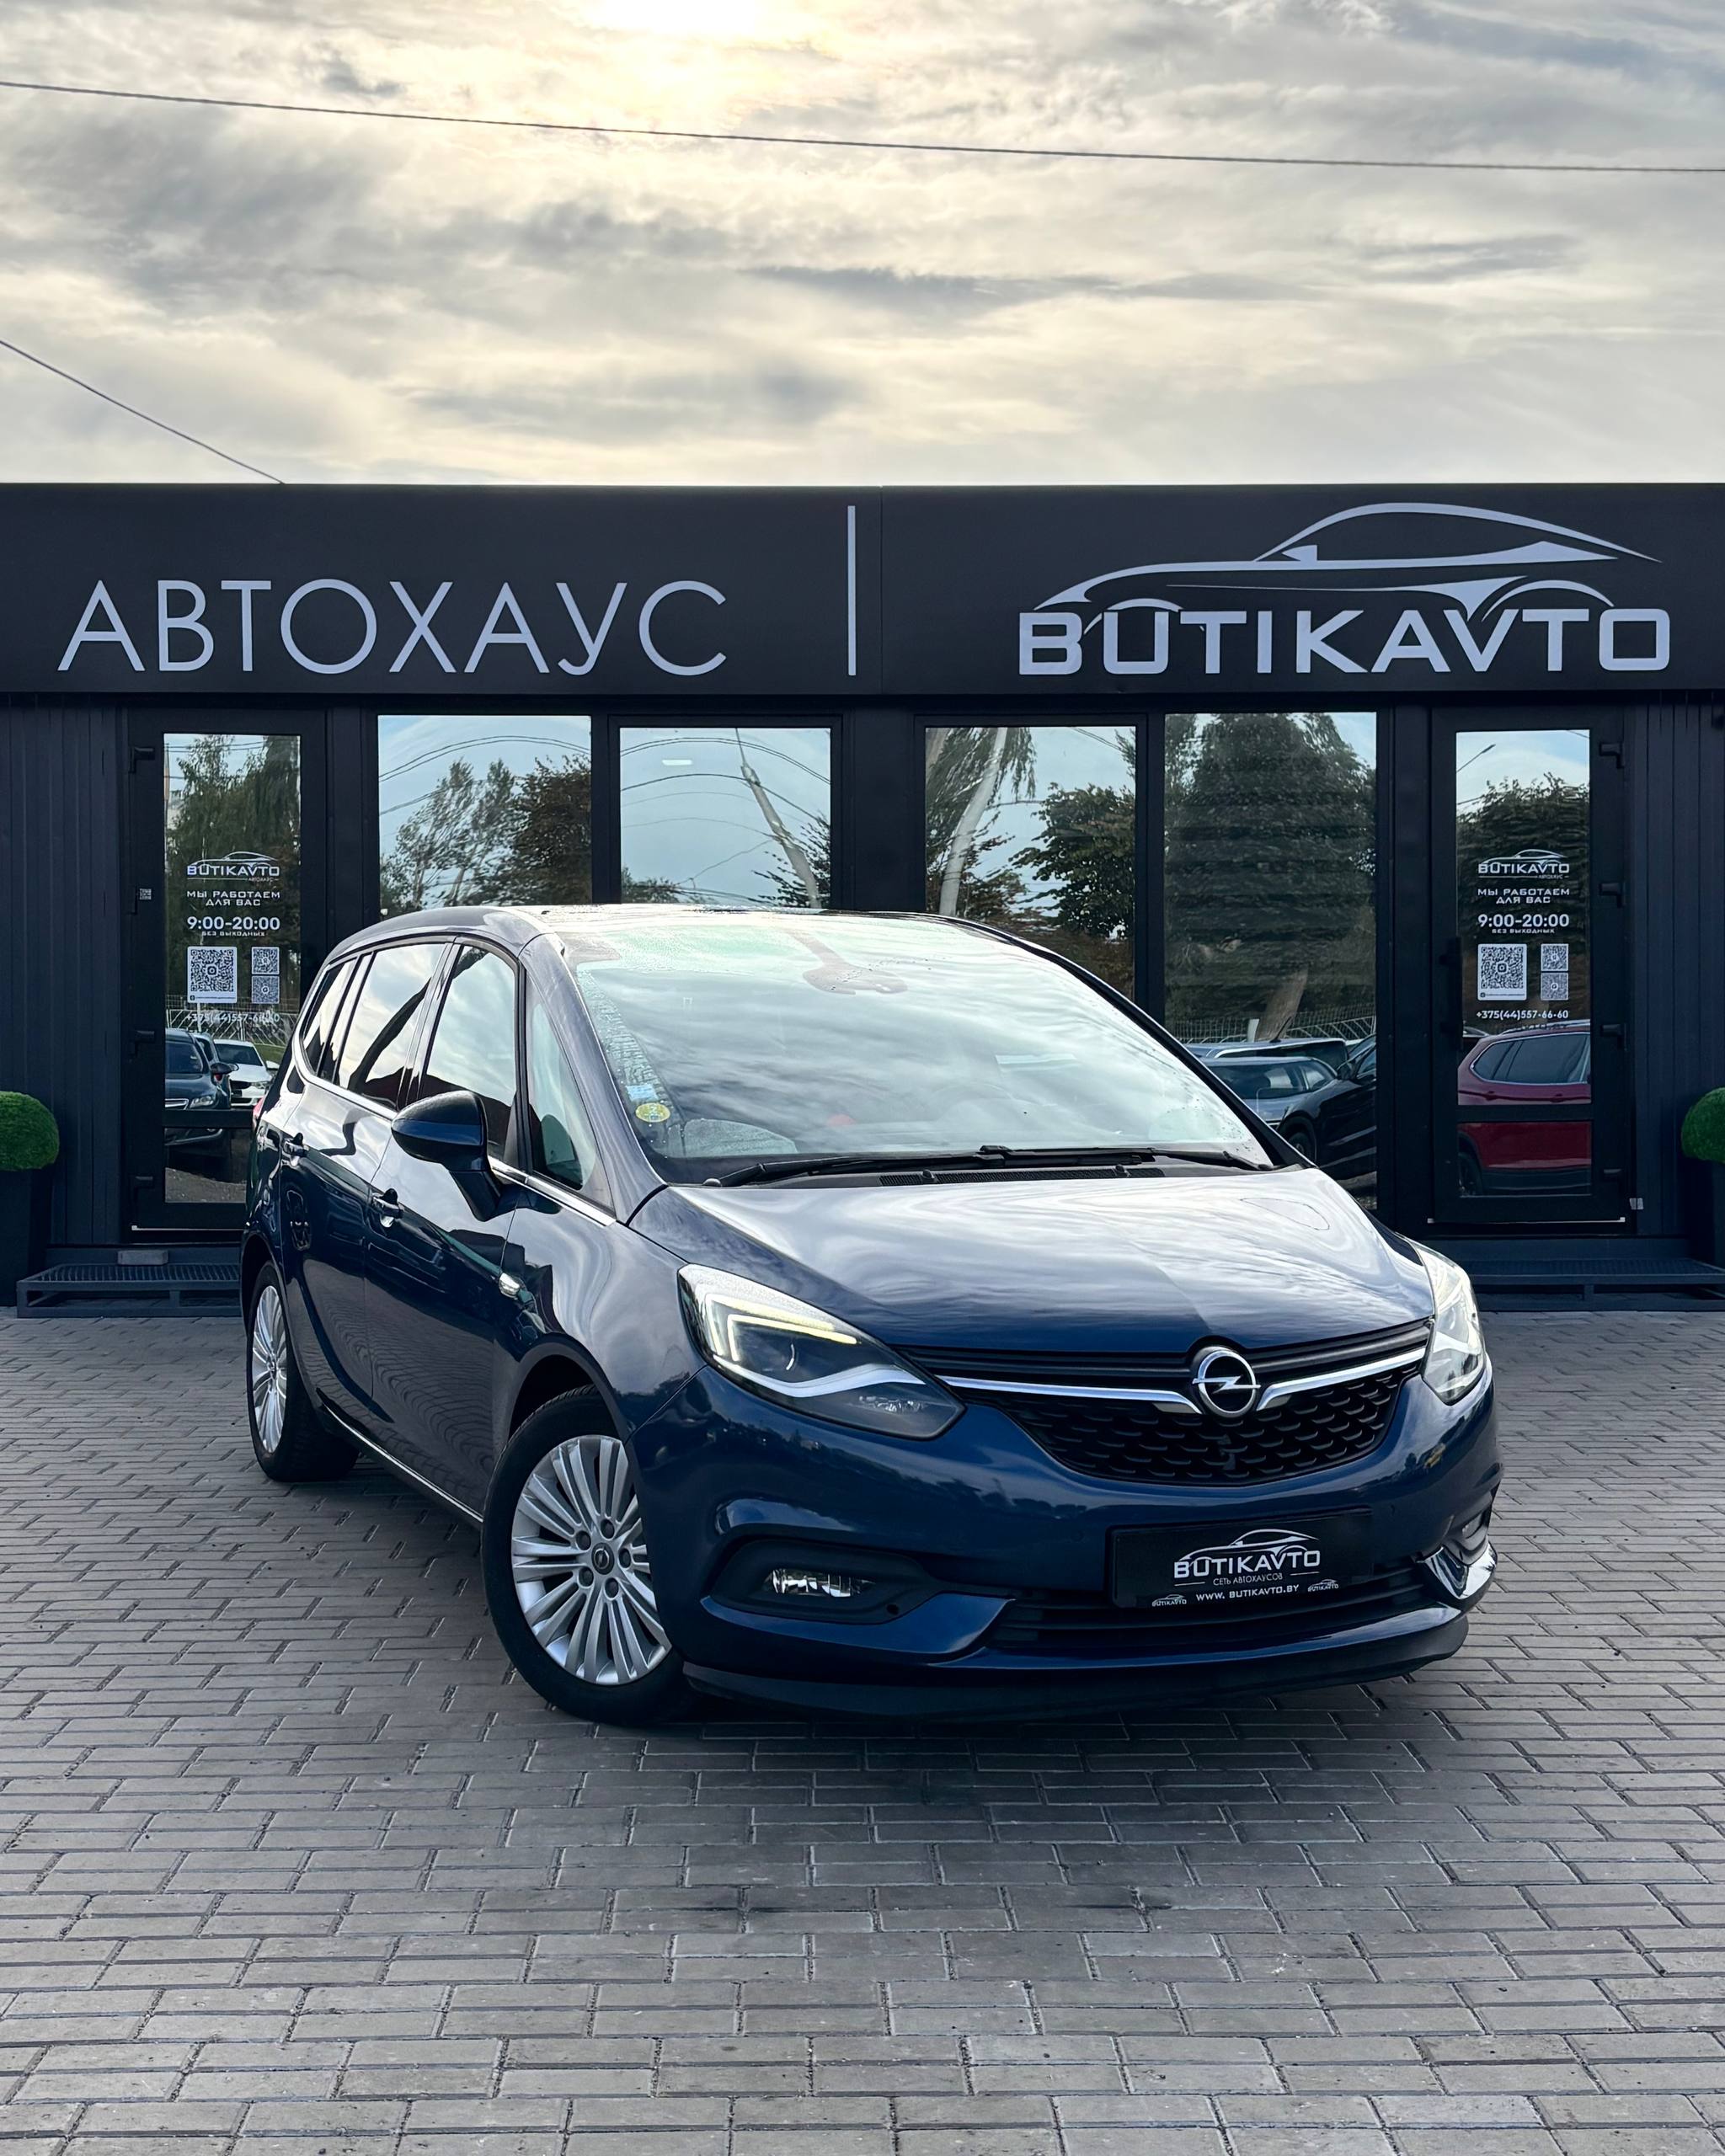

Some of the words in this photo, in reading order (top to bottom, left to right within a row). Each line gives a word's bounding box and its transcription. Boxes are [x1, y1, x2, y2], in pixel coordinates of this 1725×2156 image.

[58, 579, 727, 676] АВТОХАУС
[1019, 607, 1671, 675] BUTIKAVTO
[187, 866, 280, 876] BUTIKAVTO
[1478, 863, 1570, 874] BUTIKAVTO
[187, 890, 207, 899] МЫ
[212, 890, 280, 899] РАБОТАЕМ
[1496, 896, 1520, 905] ДЛЯ
[187, 916, 280, 930] 9:00-20:00
[1477, 914, 1570, 927] 9:00-20:00
[1173, 1550, 1321, 1578] BUTIKAVTO
[1213, 1577, 1231, 1586] СЕТЬ
[1233, 1572, 1283, 1585] АВТОХАУСОВ
[1196, 1591, 1226, 1602] WWW.
[1229, 1584, 1300, 1599] BUTIKAVTO.BY
